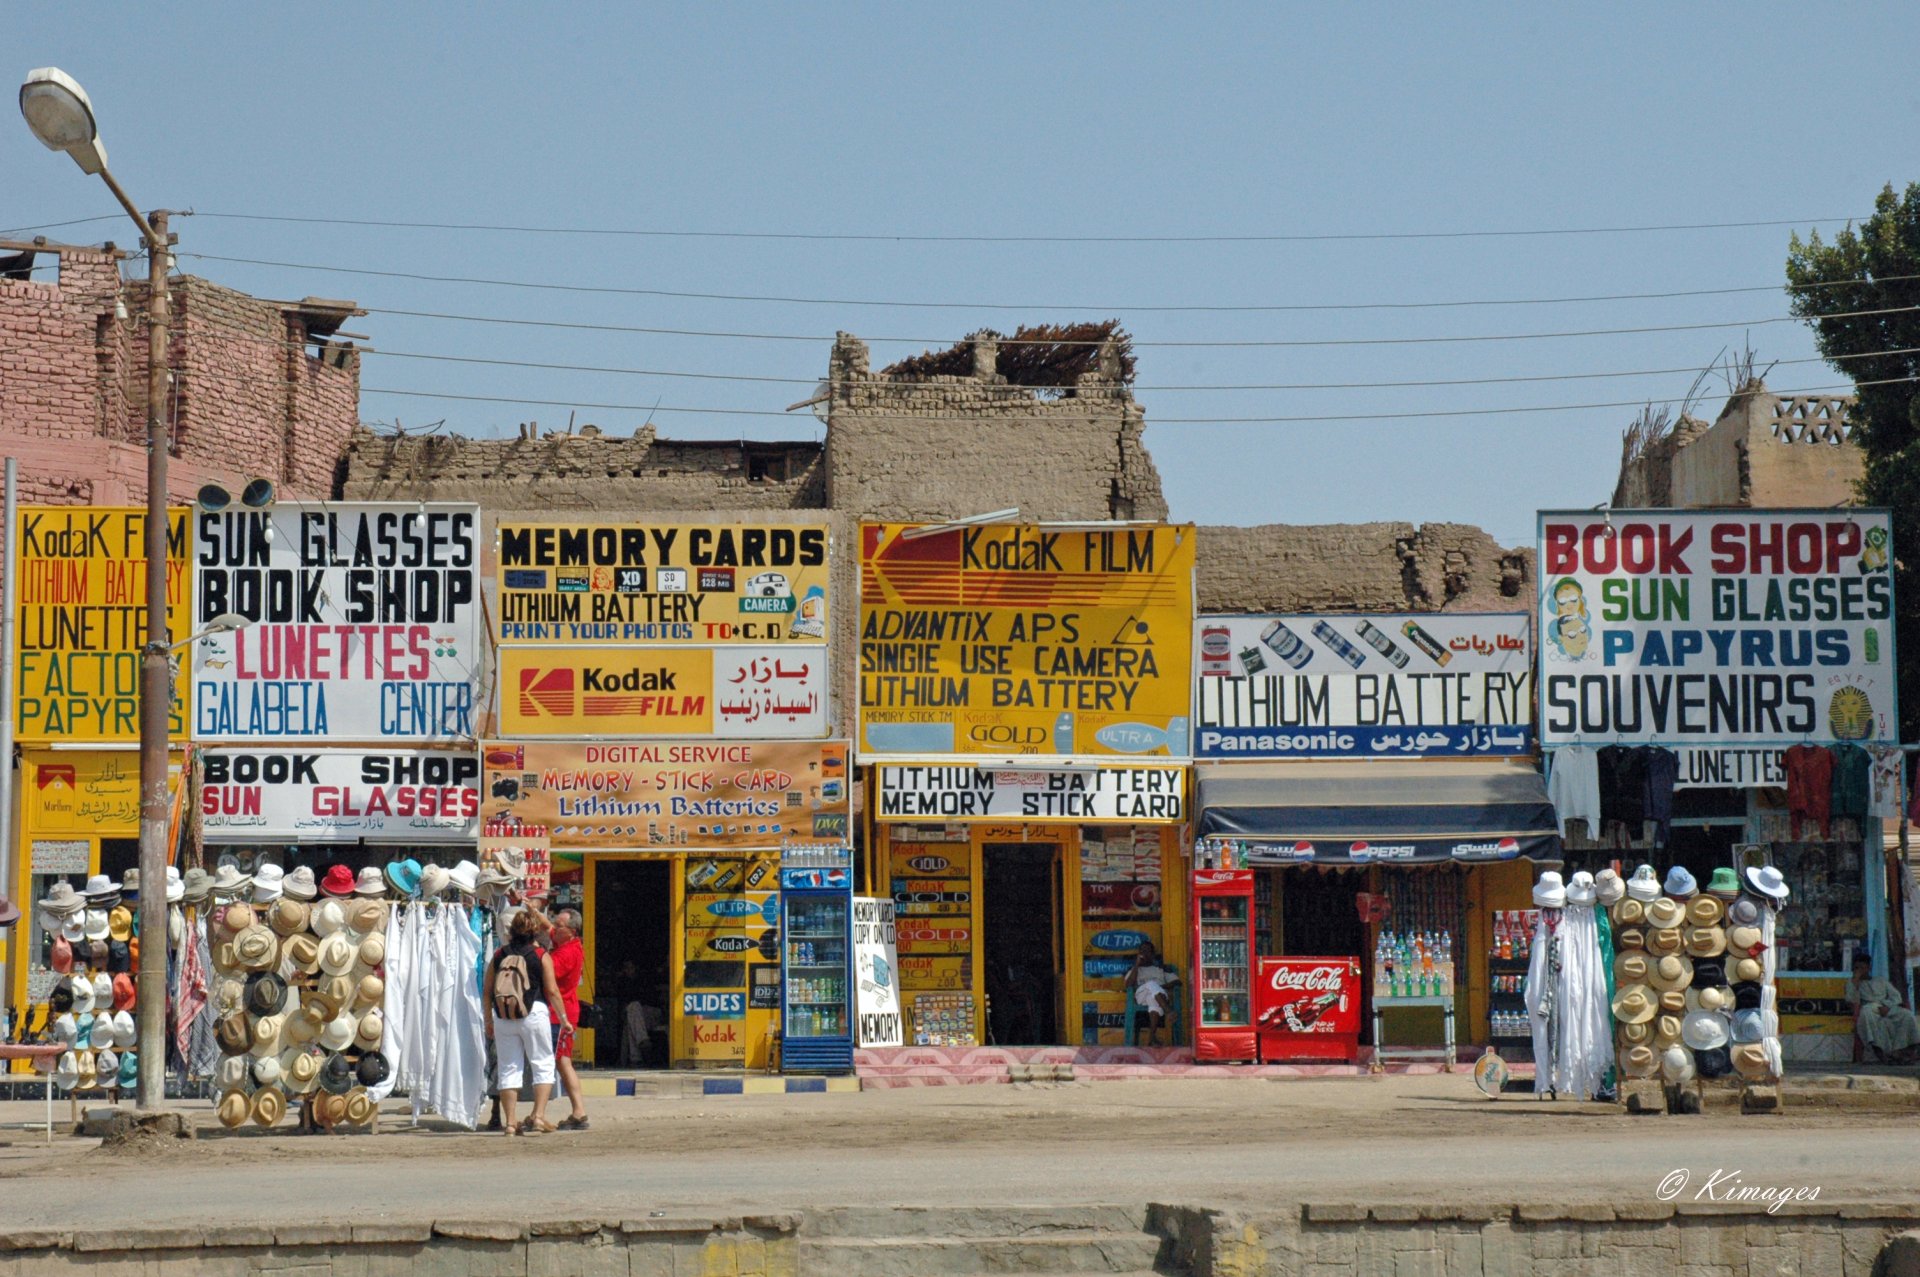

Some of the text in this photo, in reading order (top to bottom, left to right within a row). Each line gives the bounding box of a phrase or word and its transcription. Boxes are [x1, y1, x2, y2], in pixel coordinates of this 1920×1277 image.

[124, 513, 186, 559] FIM
[199, 512, 472, 567] SUN GLASSES
[501, 528, 825, 567] MEMORY CARDS
[1545, 522, 1861, 574] BOOK SHOP
[1085, 529, 1154, 573] FILM
[21, 558, 184, 605] LITHIUM BATTRY
[621, 571, 641, 585] XD
[702, 578, 730, 588] 128 MB
[203, 569, 472, 623] BOOK SHOP
[592, 593, 705, 622] BATTERY
[744, 598, 789, 612] CAMERA
[1602, 576, 1890, 621] SUN GLASSES
[501, 623, 565, 639] PRINT
[569, 623, 618, 639] YOUR
[623, 623, 693, 639] PHOTOS
[702, 623, 732, 639] TO
[235, 625, 431, 680] LUNETTES
[1449, 634, 1525, 656] بطاريات
[1602, 629, 1851, 666] PAPYRUS
[727, 656, 809, 686] بازار
[960, 645, 1013, 674] USE
[1034, 647, 1160, 678] CAMERA
[19, 652, 183, 697] FACTO
[583, 667, 677, 692] Kodak
[639, 695, 705, 716] FILM
[861, 676, 1139, 711] LITHIUM BATTERY
[1199, 672, 1528, 727] LITHIUM BATTERY
[1548, 674, 1816, 734] SOUVENIRS
[18, 698, 183, 734] PAPYRS
[199, 681, 471, 736] GALABEIA CENTER
[866, 712, 952, 723] MEMORY STICK TM
[970, 724, 1047, 744] GOLD
[1102, 730, 1153, 744] ULTRA
[1201, 731, 1355, 751] Panasonic
[1455, 727, 1525, 751] بازار
[586, 747, 752, 763] DIGITAL SERVICE
[1674, 749, 1787, 784] LUNETTES
[204, 755, 478, 785] BOOK SHOP
[541, 768, 634, 793] MEMORY
[655, 769, 714, 792] STICK
[734, 769, 793, 791] CARD
[882, 767, 994, 790] LITHIUM
[1049, 769, 1179, 793] BATTERY
[202, 786, 478, 817] SUN GLASSES
[559, 795, 780, 817] Lithium Batteries
[882, 791, 1181, 818] MEMORY STICK CARD
[912, 857, 948, 870] GOLD
[1367, 846, 1416, 858] PEPSI
[895, 892, 969, 902] GOLD
[1090, 884, 1113, 893] TDK
[715, 902, 751, 913] ULTRA
[854, 902, 876, 921] MEMORY
[894, 903, 930, 913] ULTRA
[855, 924, 896, 944] COPY ON CD
[897, 929, 968, 940] GOLD
[1098, 935, 1142, 947] ULTRA
[1271, 966, 1344, 990] Coca-Cola
[684, 994, 741, 1012] SLIDES
[693, 1024, 737, 1043] Kodak
[861, 1013, 899, 1043] MEMORY
